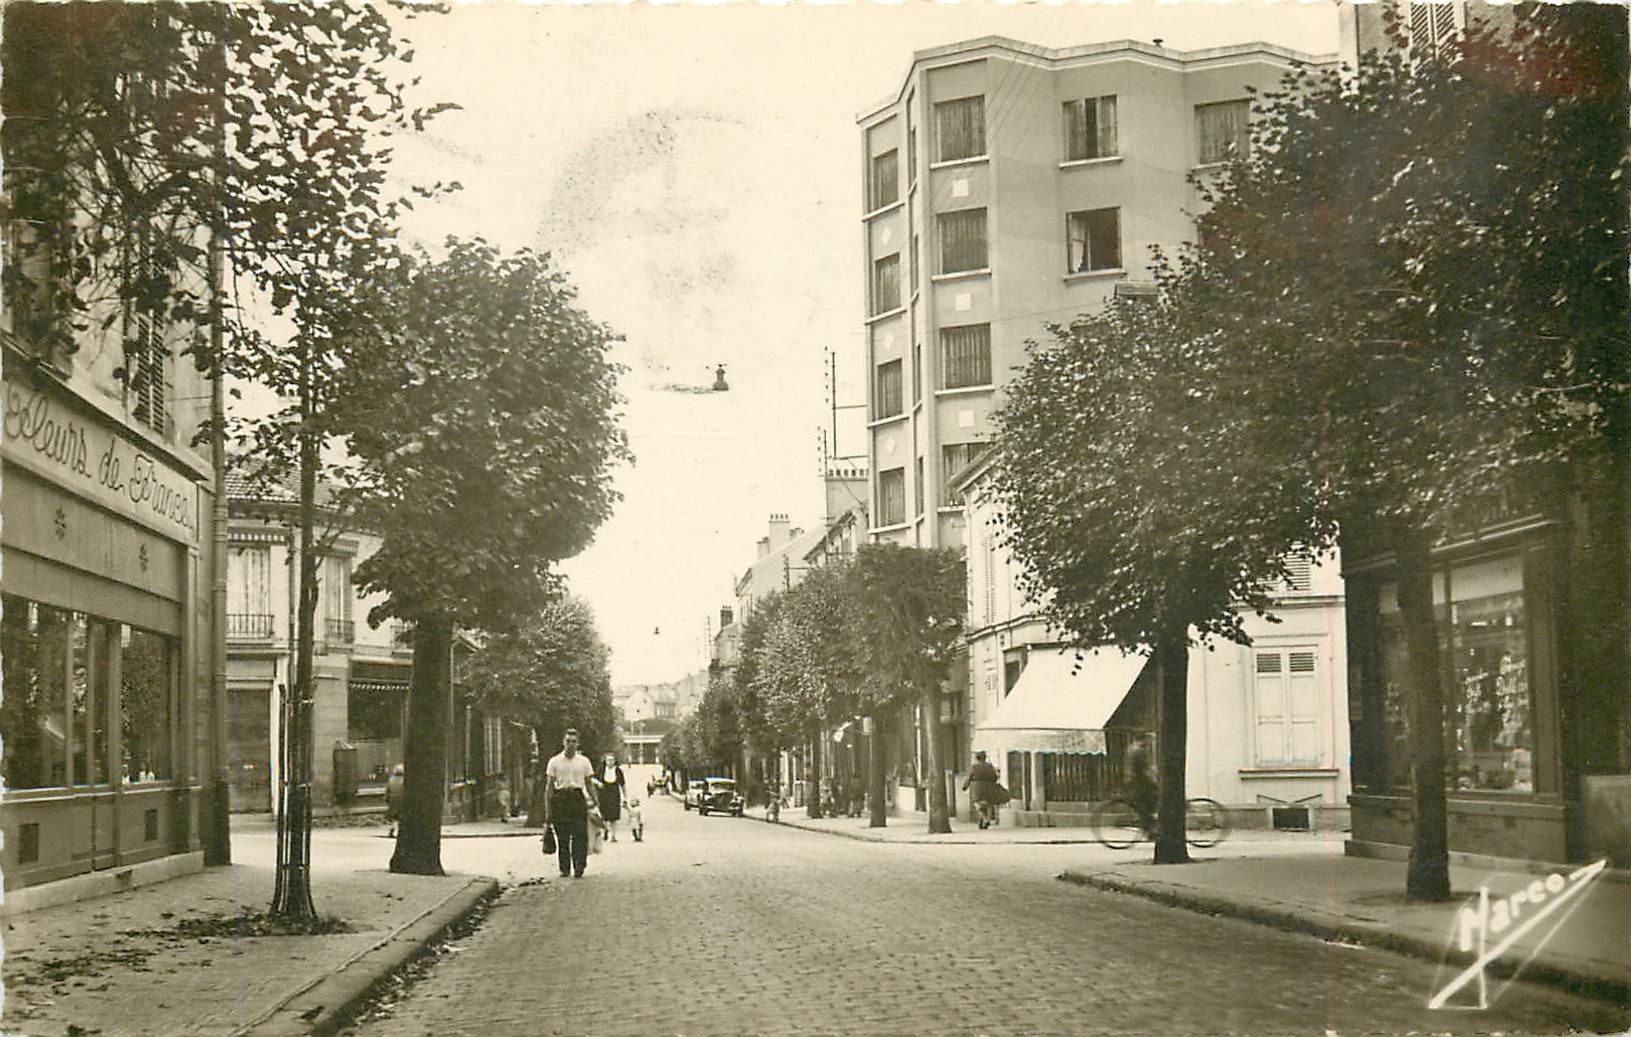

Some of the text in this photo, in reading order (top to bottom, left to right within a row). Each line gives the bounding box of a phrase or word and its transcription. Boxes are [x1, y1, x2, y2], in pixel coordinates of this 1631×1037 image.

[4, 380, 194, 530] Fleurs de France
